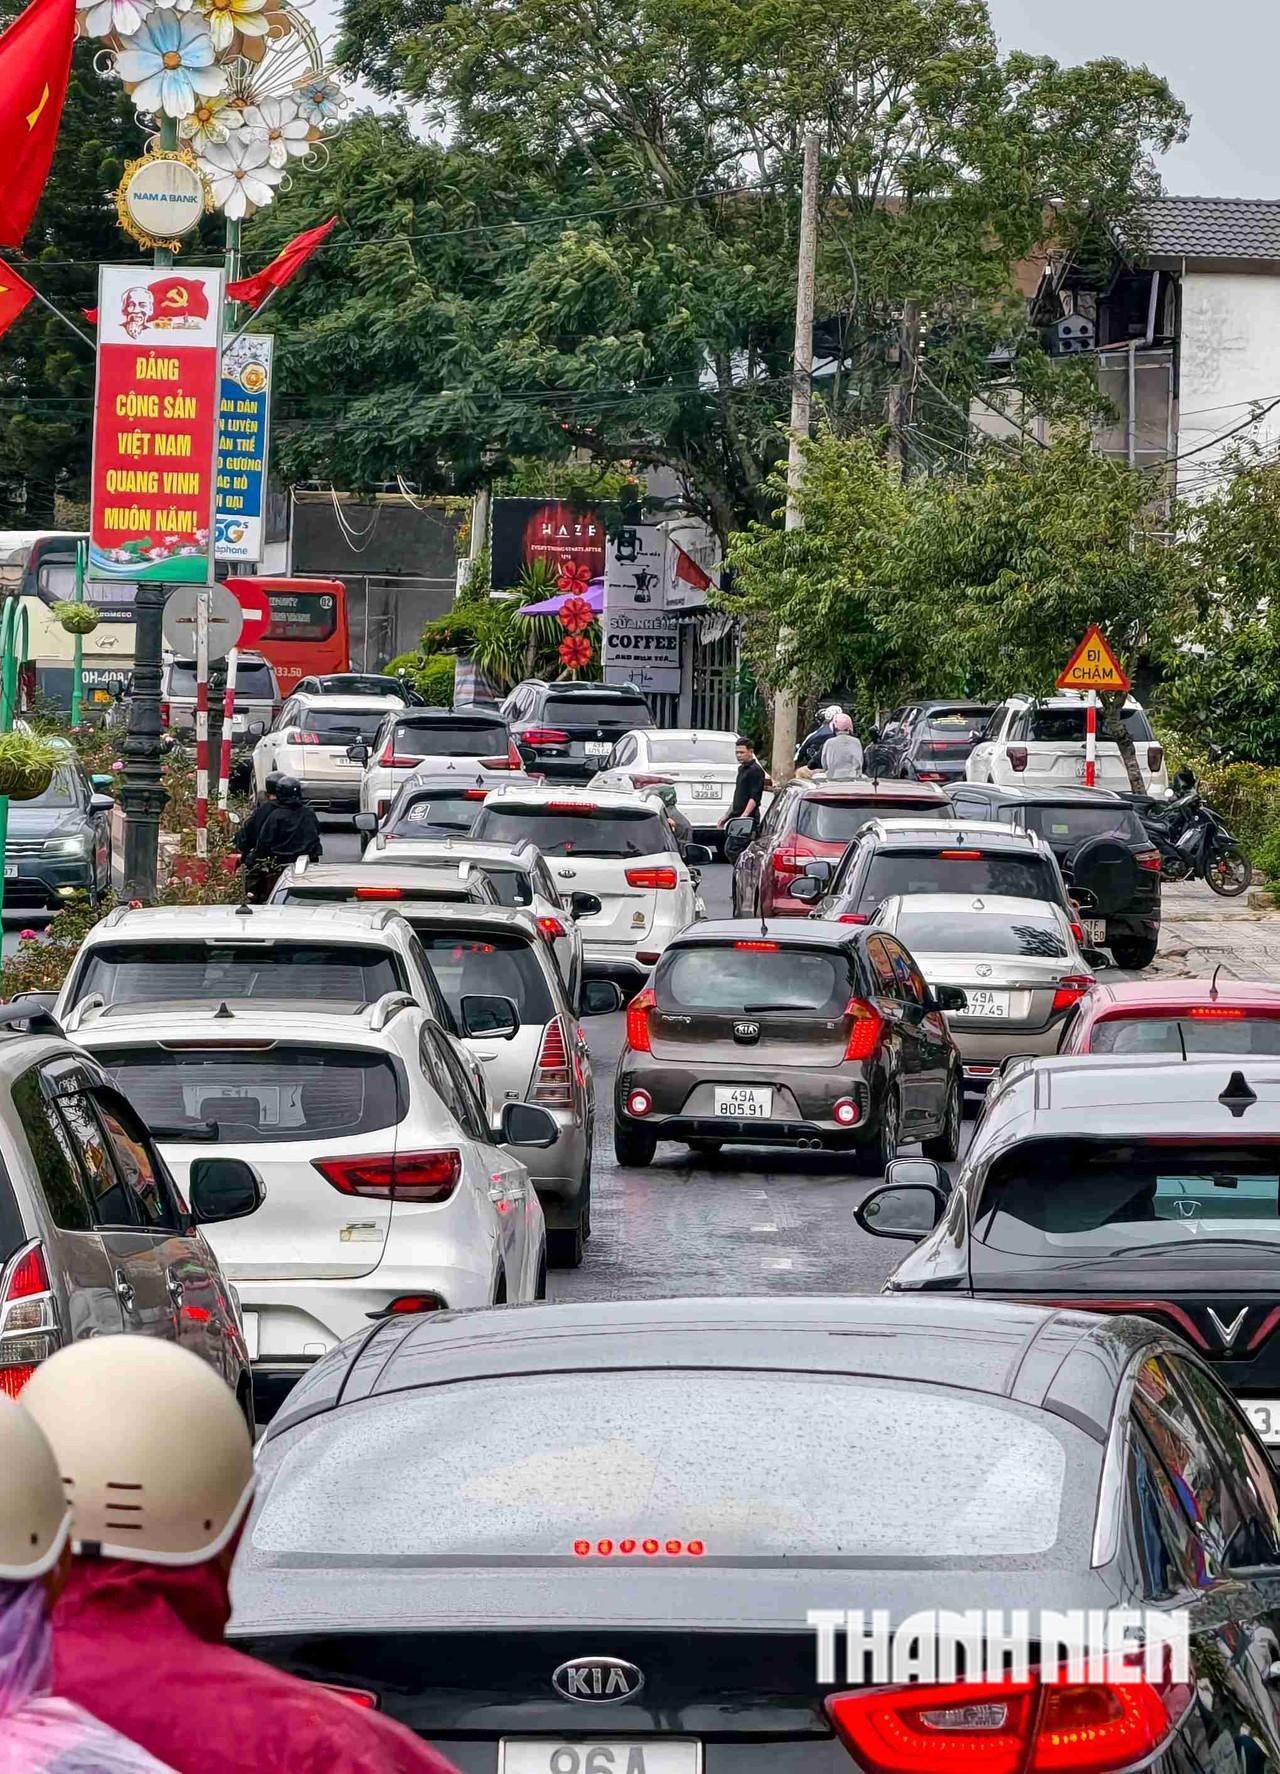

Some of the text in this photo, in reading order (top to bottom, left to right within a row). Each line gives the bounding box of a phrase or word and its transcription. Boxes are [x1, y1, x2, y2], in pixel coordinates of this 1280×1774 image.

[133, 192, 198, 203] NAM A BANK
[136, 351, 180, 381] ĐẢNG
[116, 389, 197, 422] CỘNG SẢN
[118, 428, 191, 459] VIỆT NAM
[106, 469, 200, 496] QUANG VINH
[104, 504, 198, 533] MUÔN NĂM!
[542, 523, 597, 538] HAZE
[607, 634, 677, 650] COFFEE
[1072, 664, 1113, 682] CHẬM
[972, 991, 994, 1003] 49A
[737, 1024, 755, 1034] KIA
[731, 1090, 755, 1103] 49A
[720, 1102, 764, 1117] 805.91
[567, 1667, 631, 1694] KIA
